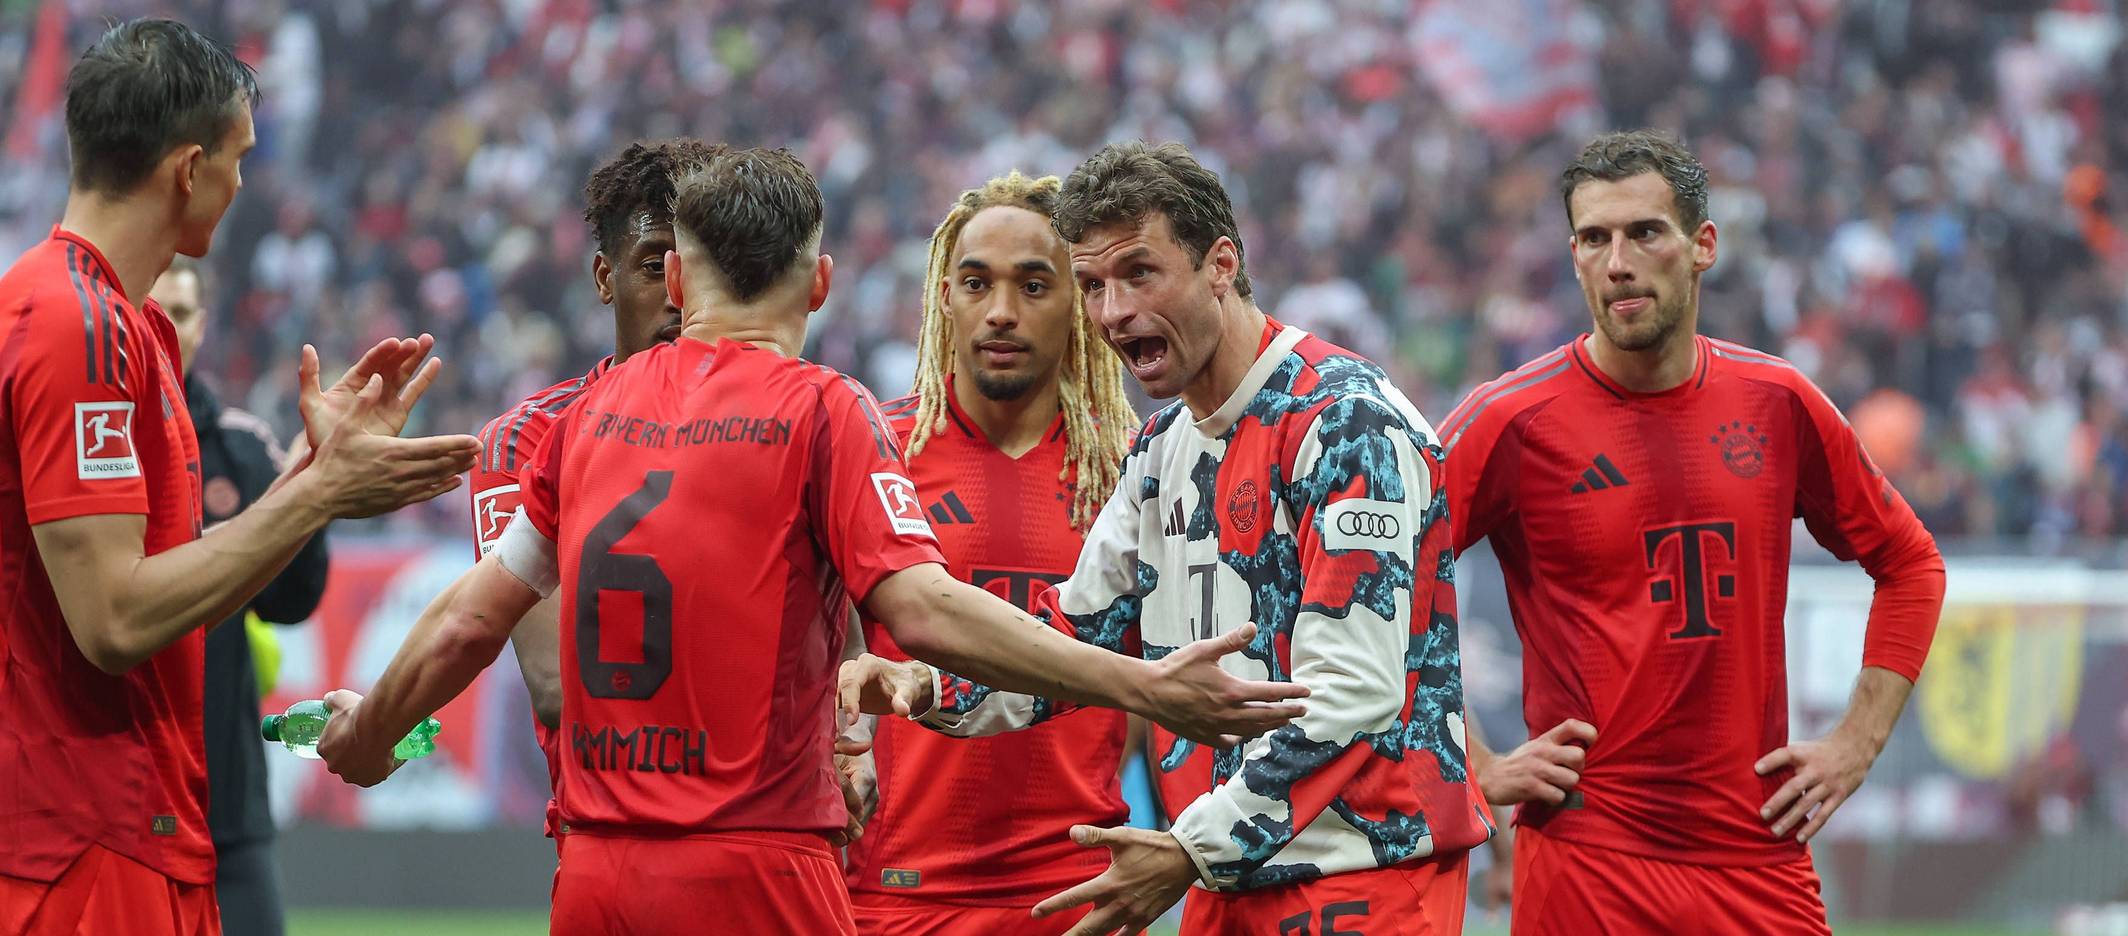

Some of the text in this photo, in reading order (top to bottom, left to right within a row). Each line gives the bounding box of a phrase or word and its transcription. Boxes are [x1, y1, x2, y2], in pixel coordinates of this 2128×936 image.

[674, 415, 792, 448] MÜNCHEN
[83, 462, 135, 472] BUNDESLIGA
[576, 470, 675, 701] 6
[1644, 521, 1736, 640] T
[573, 720, 707, 776] KMMICH
